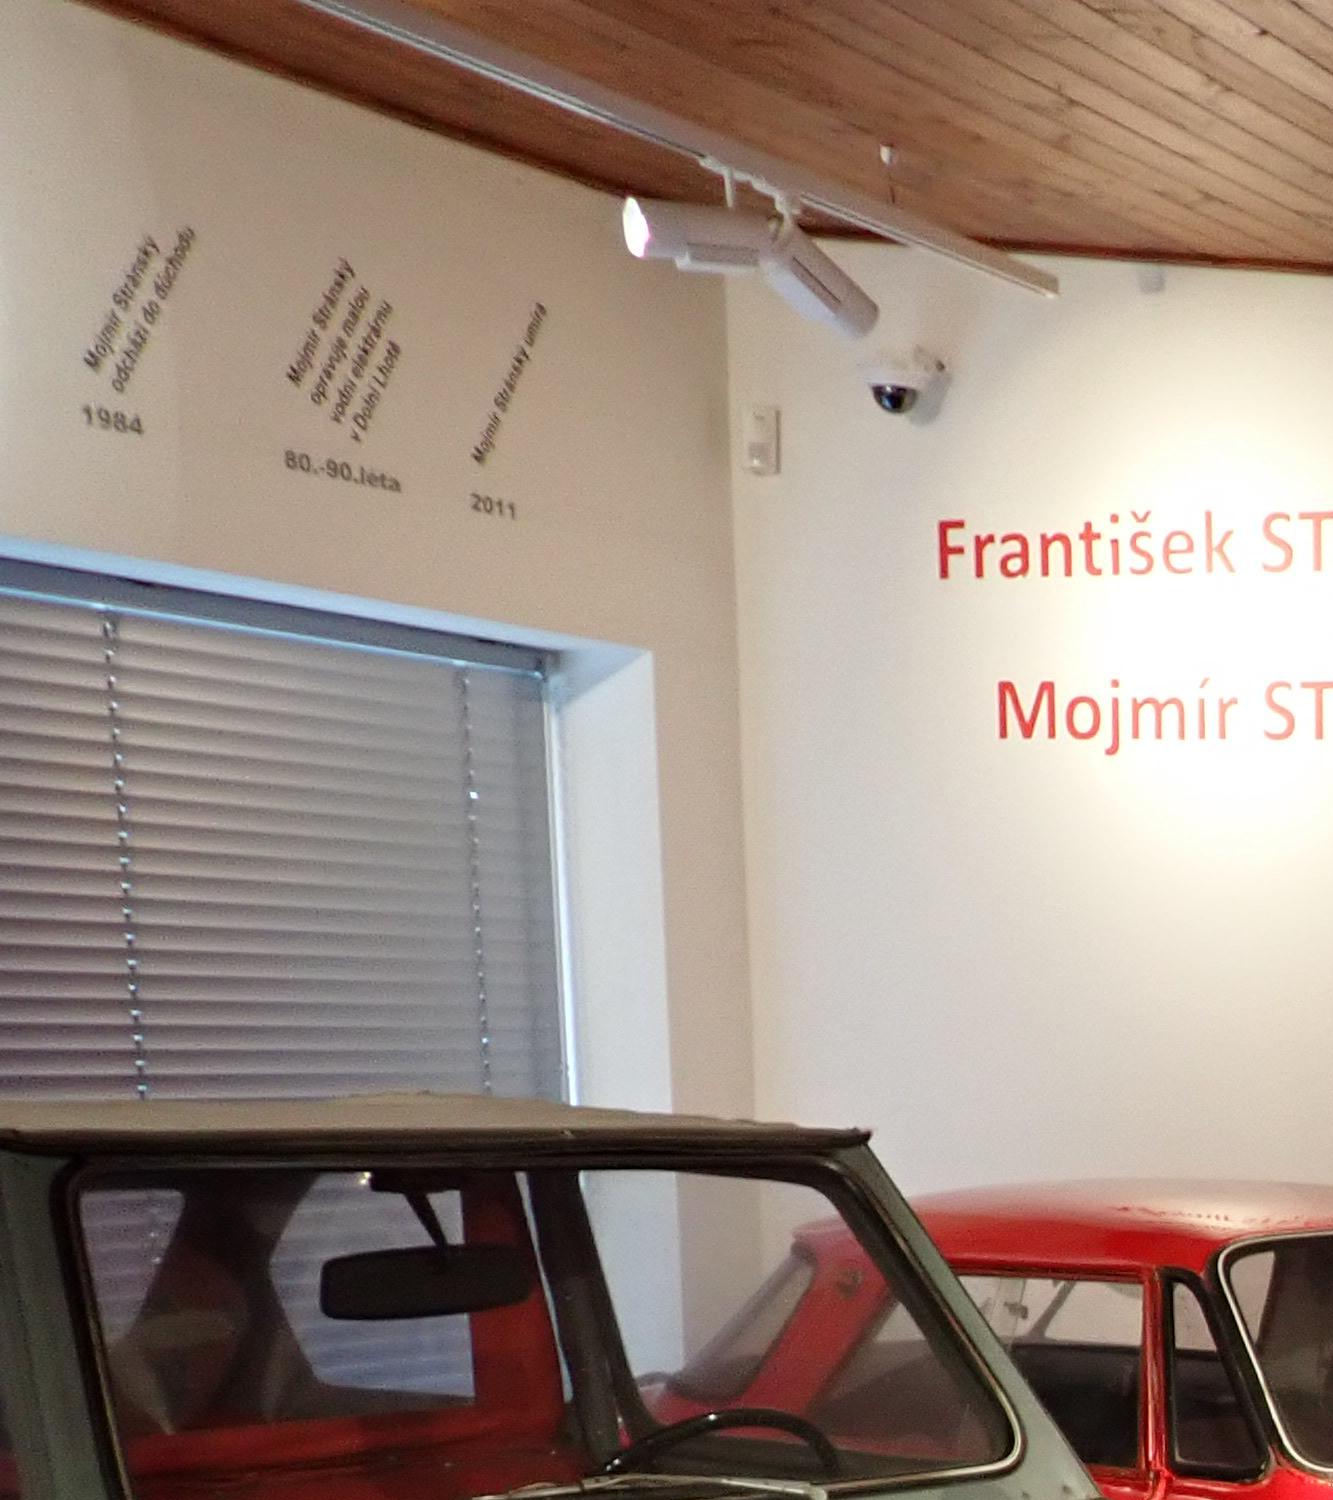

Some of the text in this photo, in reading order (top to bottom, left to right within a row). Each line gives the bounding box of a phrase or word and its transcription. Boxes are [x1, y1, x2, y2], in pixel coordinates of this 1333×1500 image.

[142, 299, 162, 326] do
[342, 286, 371, 337] malou
[82, 405, 144, 435] 1984
[471, 493, 516, 520] 2011
[937, 509, 1236, 581] František
[996, 678, 1238, 756] Mojmír
